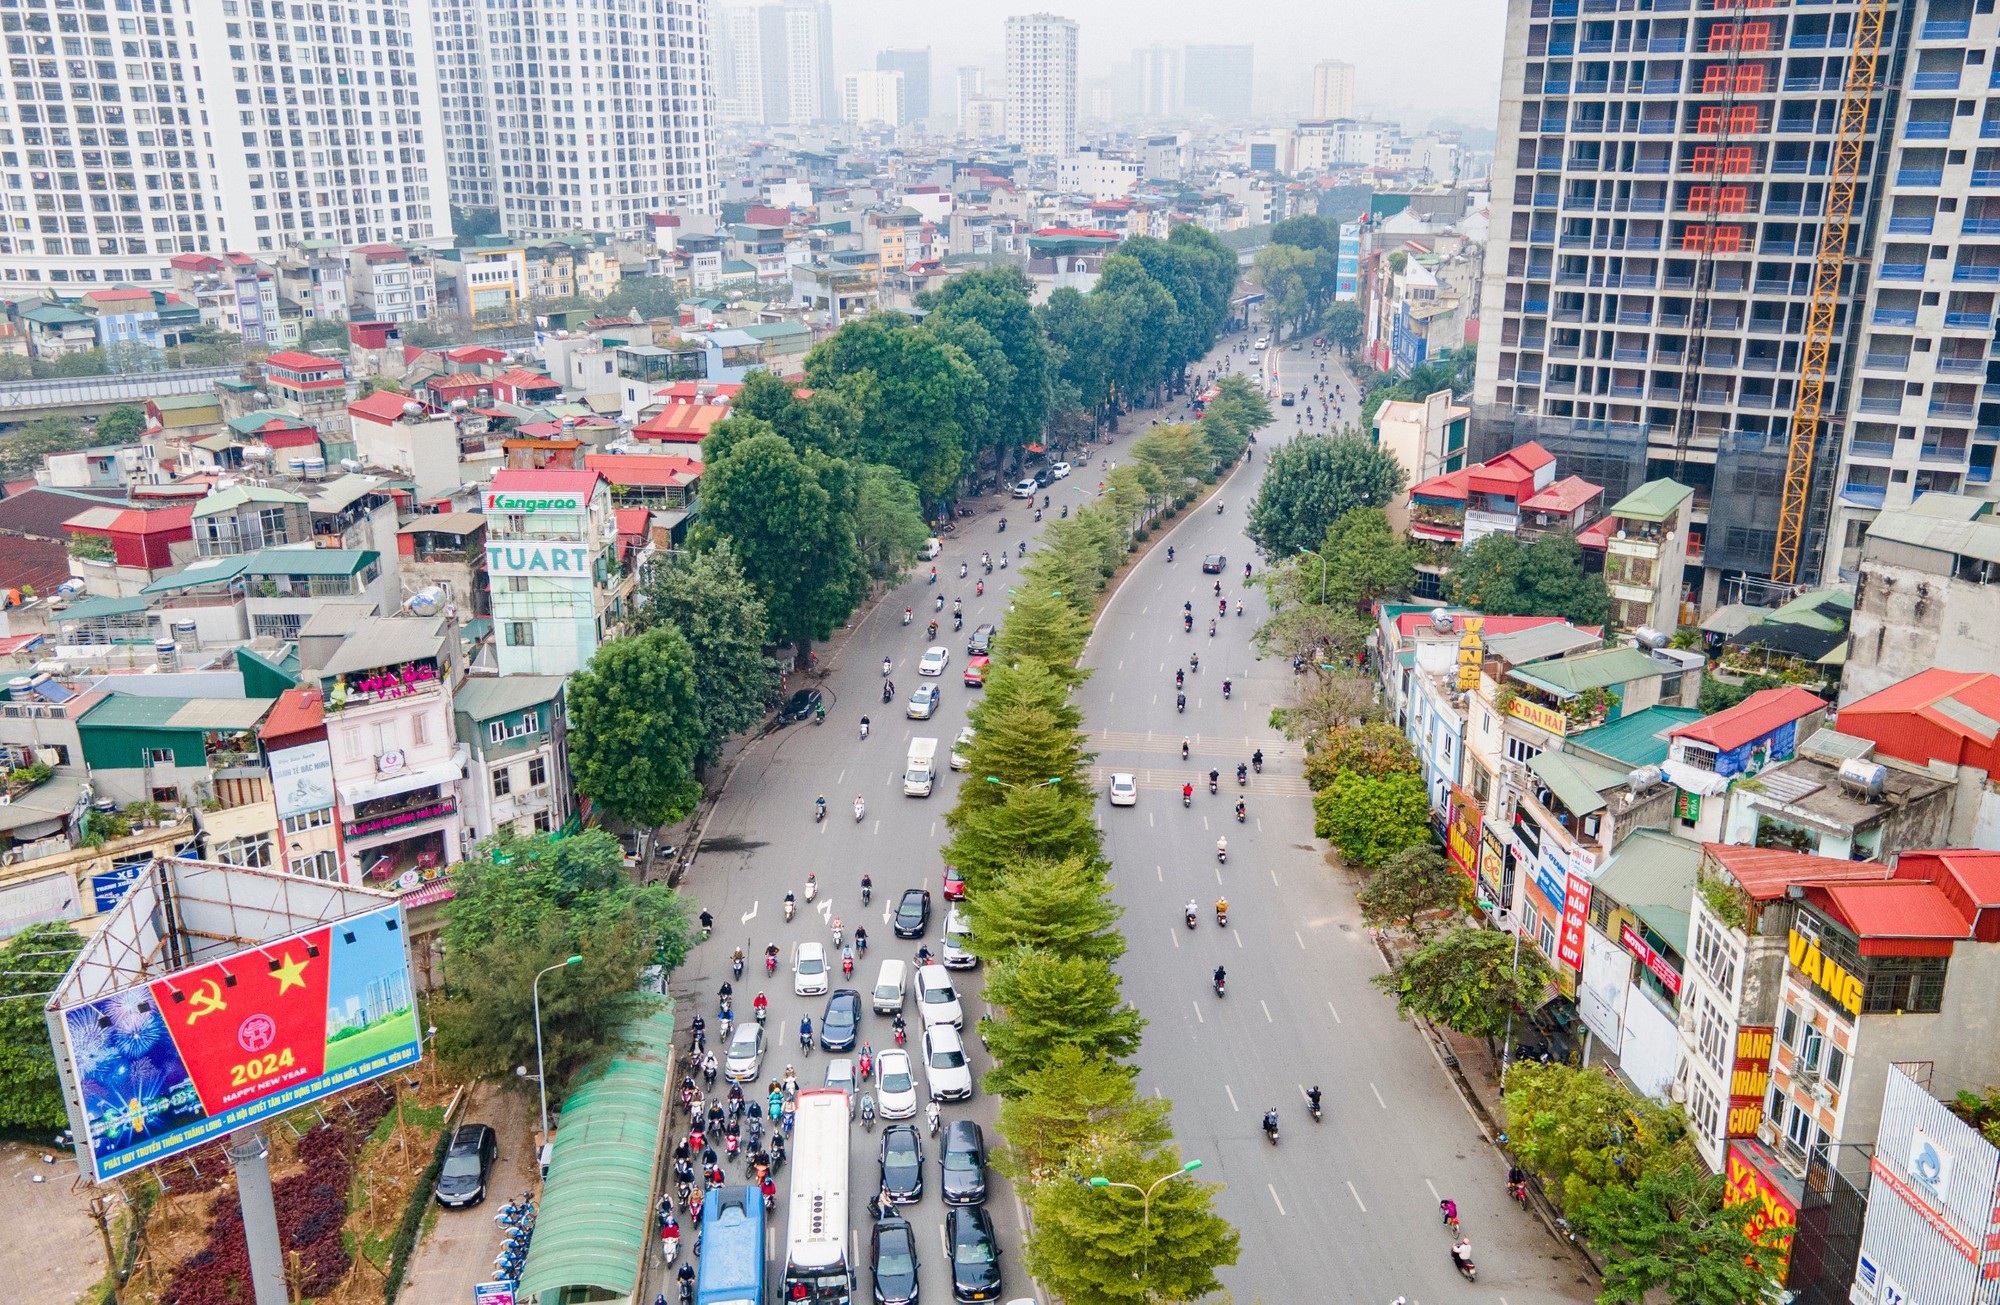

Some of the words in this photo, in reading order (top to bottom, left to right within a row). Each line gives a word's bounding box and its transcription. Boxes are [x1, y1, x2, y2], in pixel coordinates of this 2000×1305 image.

[488, 494, 577, 512] Kangaroo
[486, 547, 588, 571] TUART
[358, 672, 400, 692] VUA
[117, 869, 133, 879] XE
[1569, 877, 1589, 898] THAY
[1562, 945, 1579, 964] QUY
[1623, 930, 1646, 958] MOTUL
[1788, 928, 1863, 1016] VÀNG
[1737, 1029, 1772, 1059] VÀNG
[230, 1048, 295, 1087] 2024
[1730, 1062, 1768, 1096] NHẪN
[223, 1086, 255, 1103] HAPPY
[257, 1076, 281, 1092] NEW
[281, 1067, 307, 1082] YEAR
[1728, 1102, 1762, 1134] CƯỚI
[1731, 1157, 1790, 1228] VÀNG
